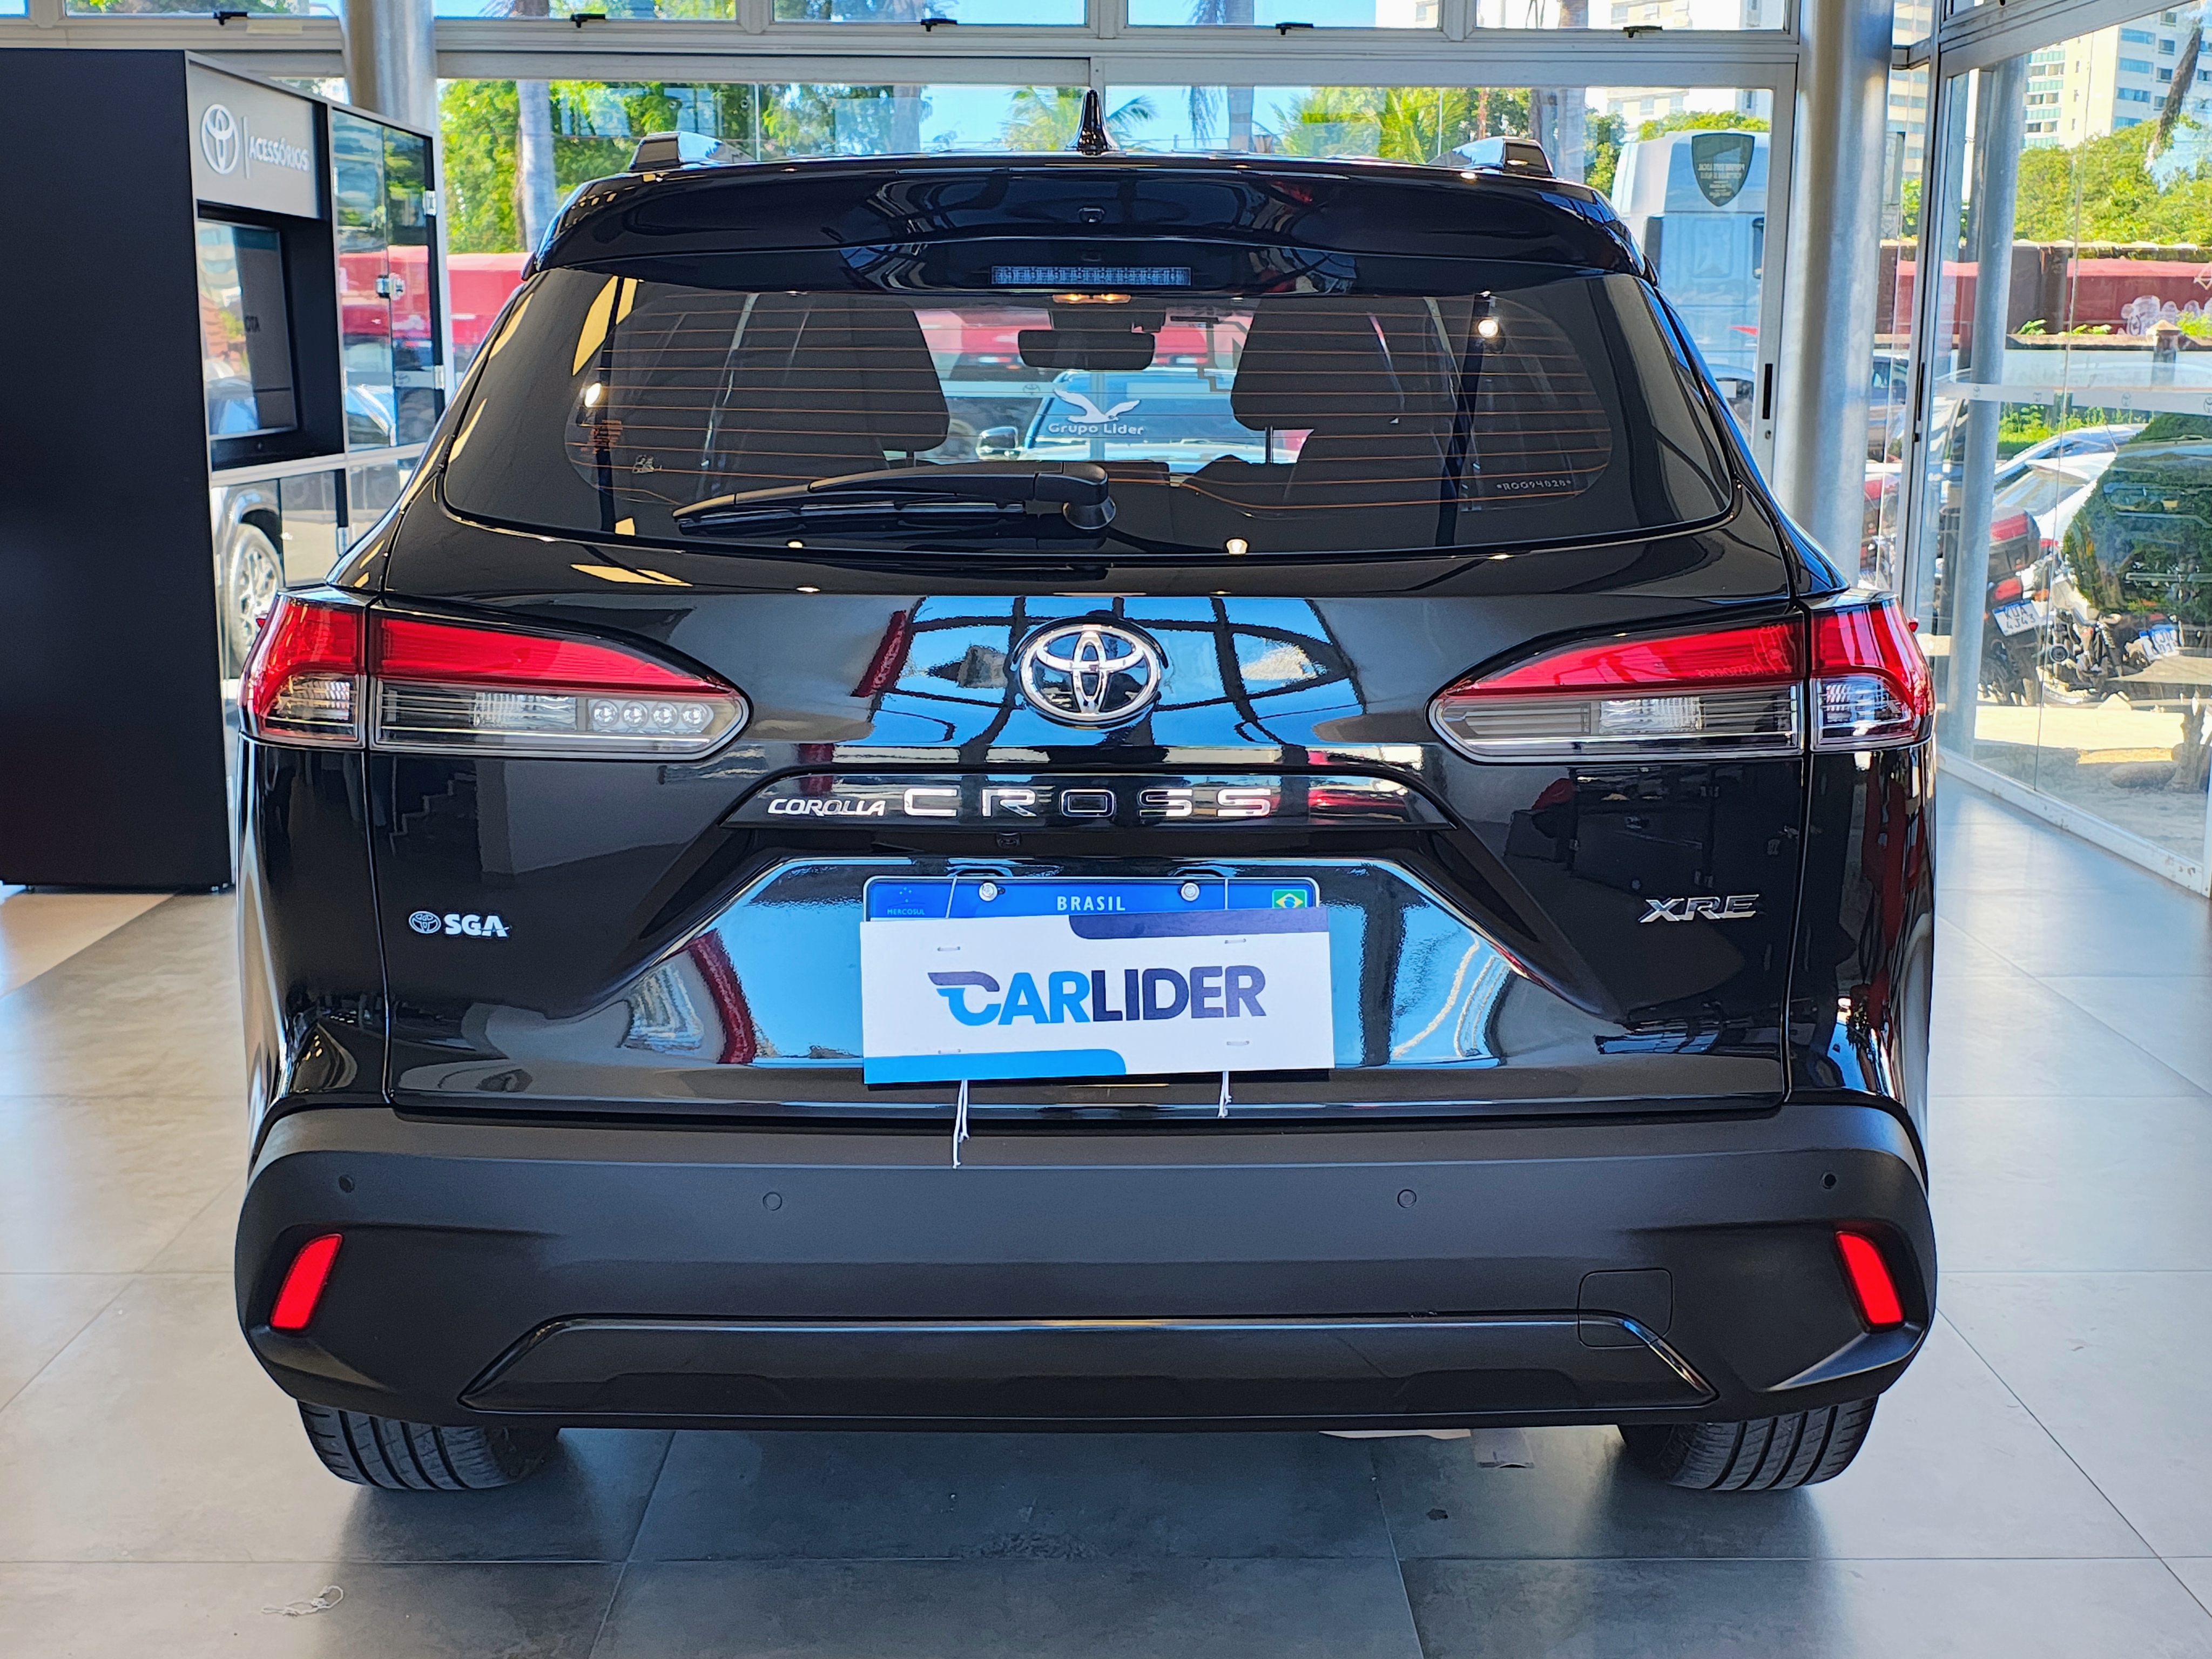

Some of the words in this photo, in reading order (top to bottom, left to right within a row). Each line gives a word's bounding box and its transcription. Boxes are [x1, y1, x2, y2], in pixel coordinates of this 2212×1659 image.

[249, 136, 310, 172] ACESSÓRIOS
[1048, 423, 1098, 435] Grupo
[767, 798, 886, 817] COROLLA
[903, 788, 1272, 818] CROSS
[1057, 896, 1126, 911] BRASIL
[1637, 894, 1759, 923] XRE
[444, 914, 511, 938] SGA
[927, 965, 1267, 1026] CARLIDER
